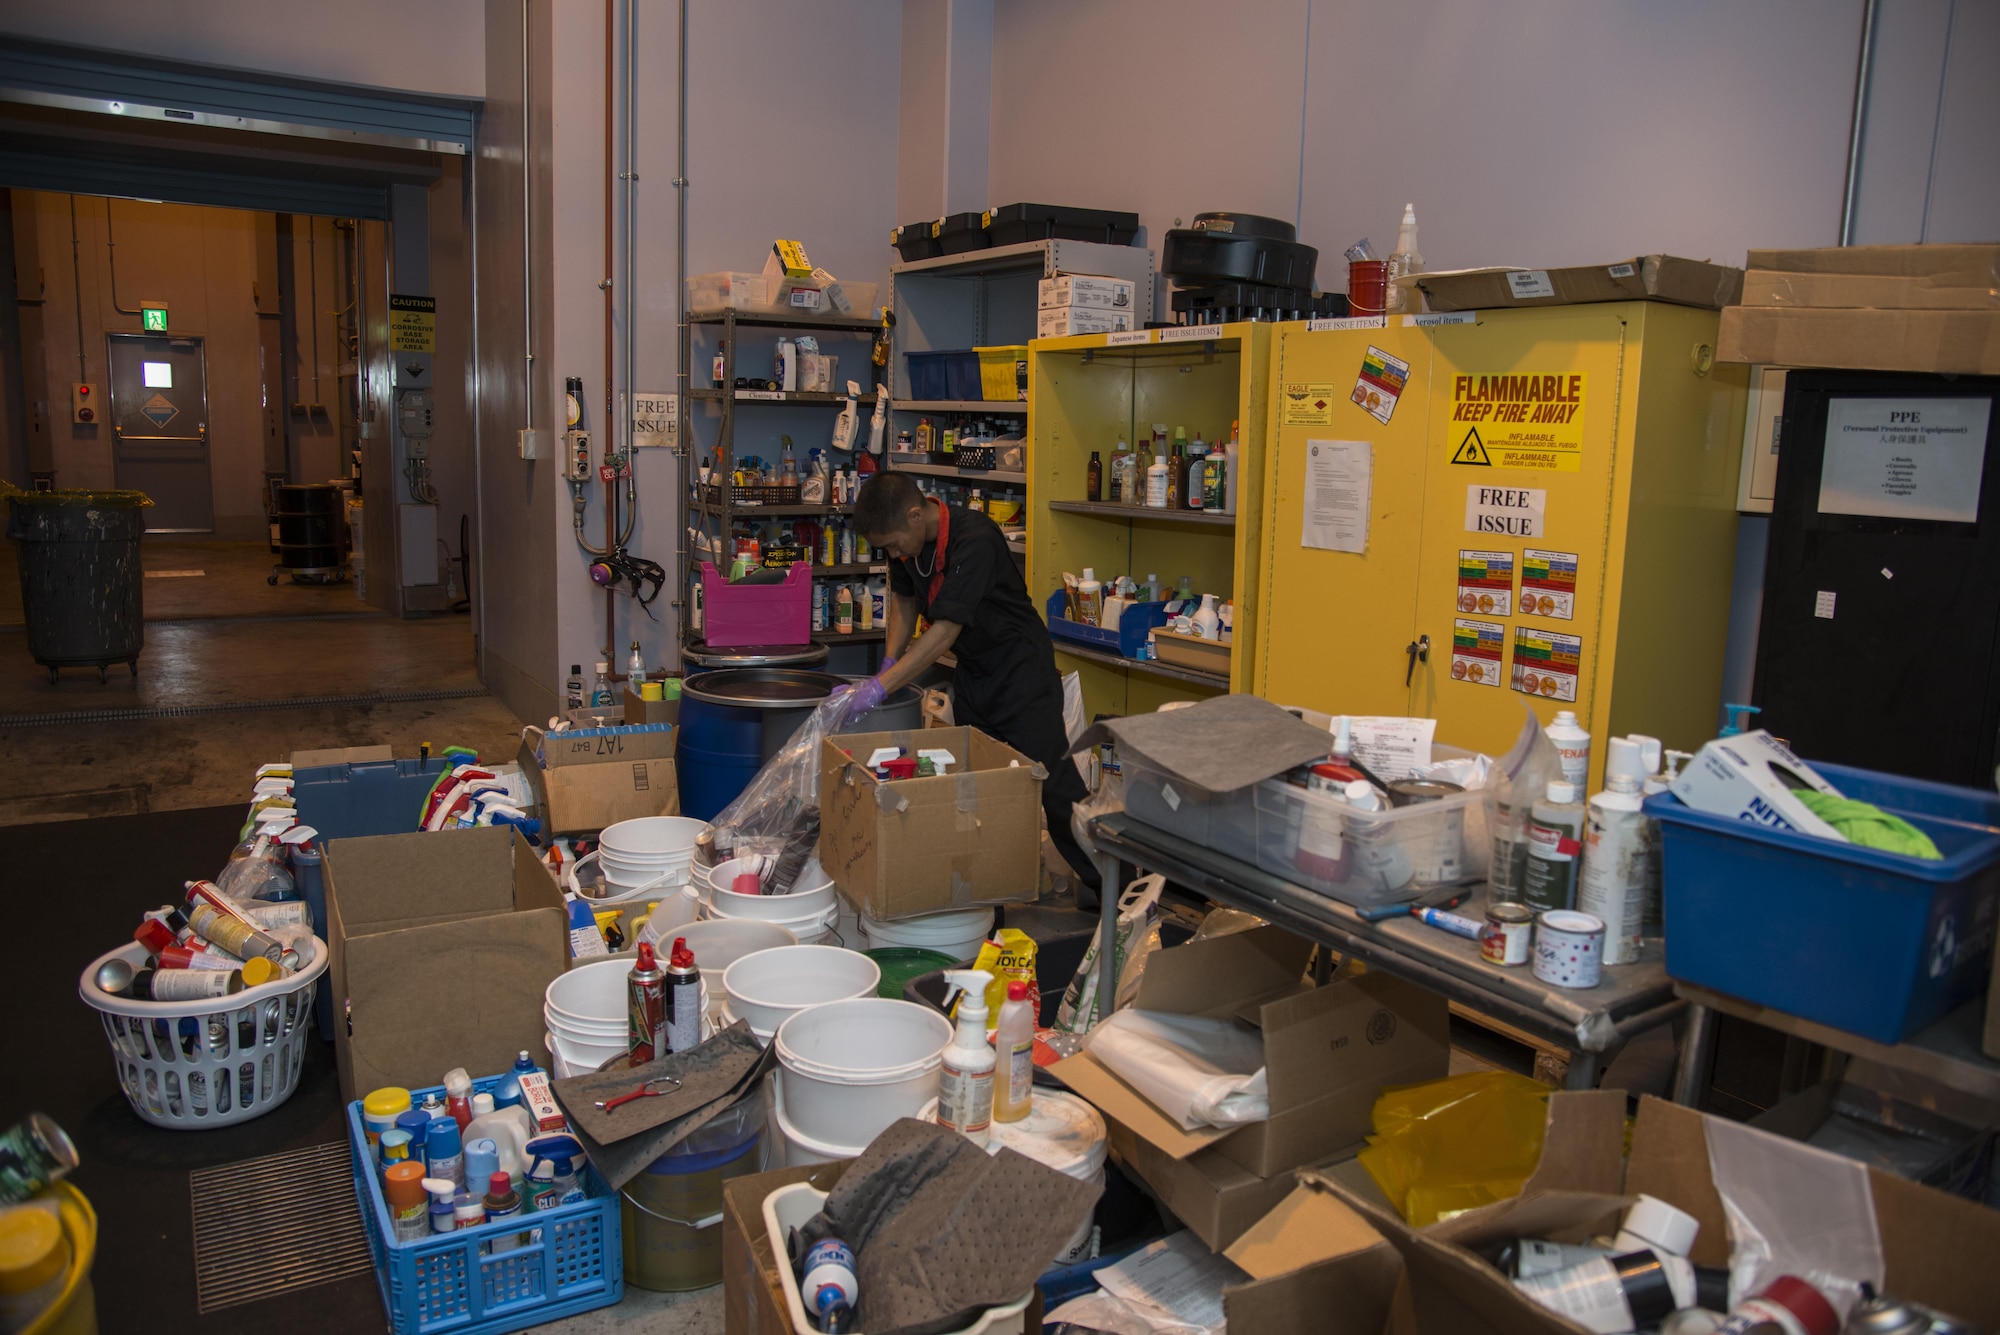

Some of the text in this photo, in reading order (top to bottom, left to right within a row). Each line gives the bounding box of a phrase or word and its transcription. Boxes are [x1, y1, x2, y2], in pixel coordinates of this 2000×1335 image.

[392, 298, 434, 308] CAUTION
[1313, 319, 1380, 331] FREE ISSUE ITEMS
[1414, 315, 1464, 326] Aerosol items
[392, 324, 434, 332] CORROSIVE
[1165, 327, 1216, 338] FREE ISSUE ITEMS
[396, 337, 430, 345] STORAGE
[1112, 333, 1146, 343] Japanese items
[1288, 385, 1309, 393] EAGLE
[1455, 375, 1581, 402] FLAMMABLE
[748, 391, 773, 400] Cleaning
[636, 401, 676, 414] FREE
[1453, 403, 1579, 424] KEEP FIRE AWAY
[1889, 412, 1921, 424] PPE
[633, 420, 677, 433] ISSUE
[1843, 425, 1879, 433] (Personal
[1509, 433, 1555, 441] INFLAMABLE
[1504, 452, 1557, 462] INFLAMMABLE
[604, 467, 628, 479] CLOED
[1479, 488, 1530, 508] FREE
[1477, 514, 1533, 536] ISSUE
[571, 735, 624, 755] 1A7 B47
[528, 1087, 544, 1106] BORAX
